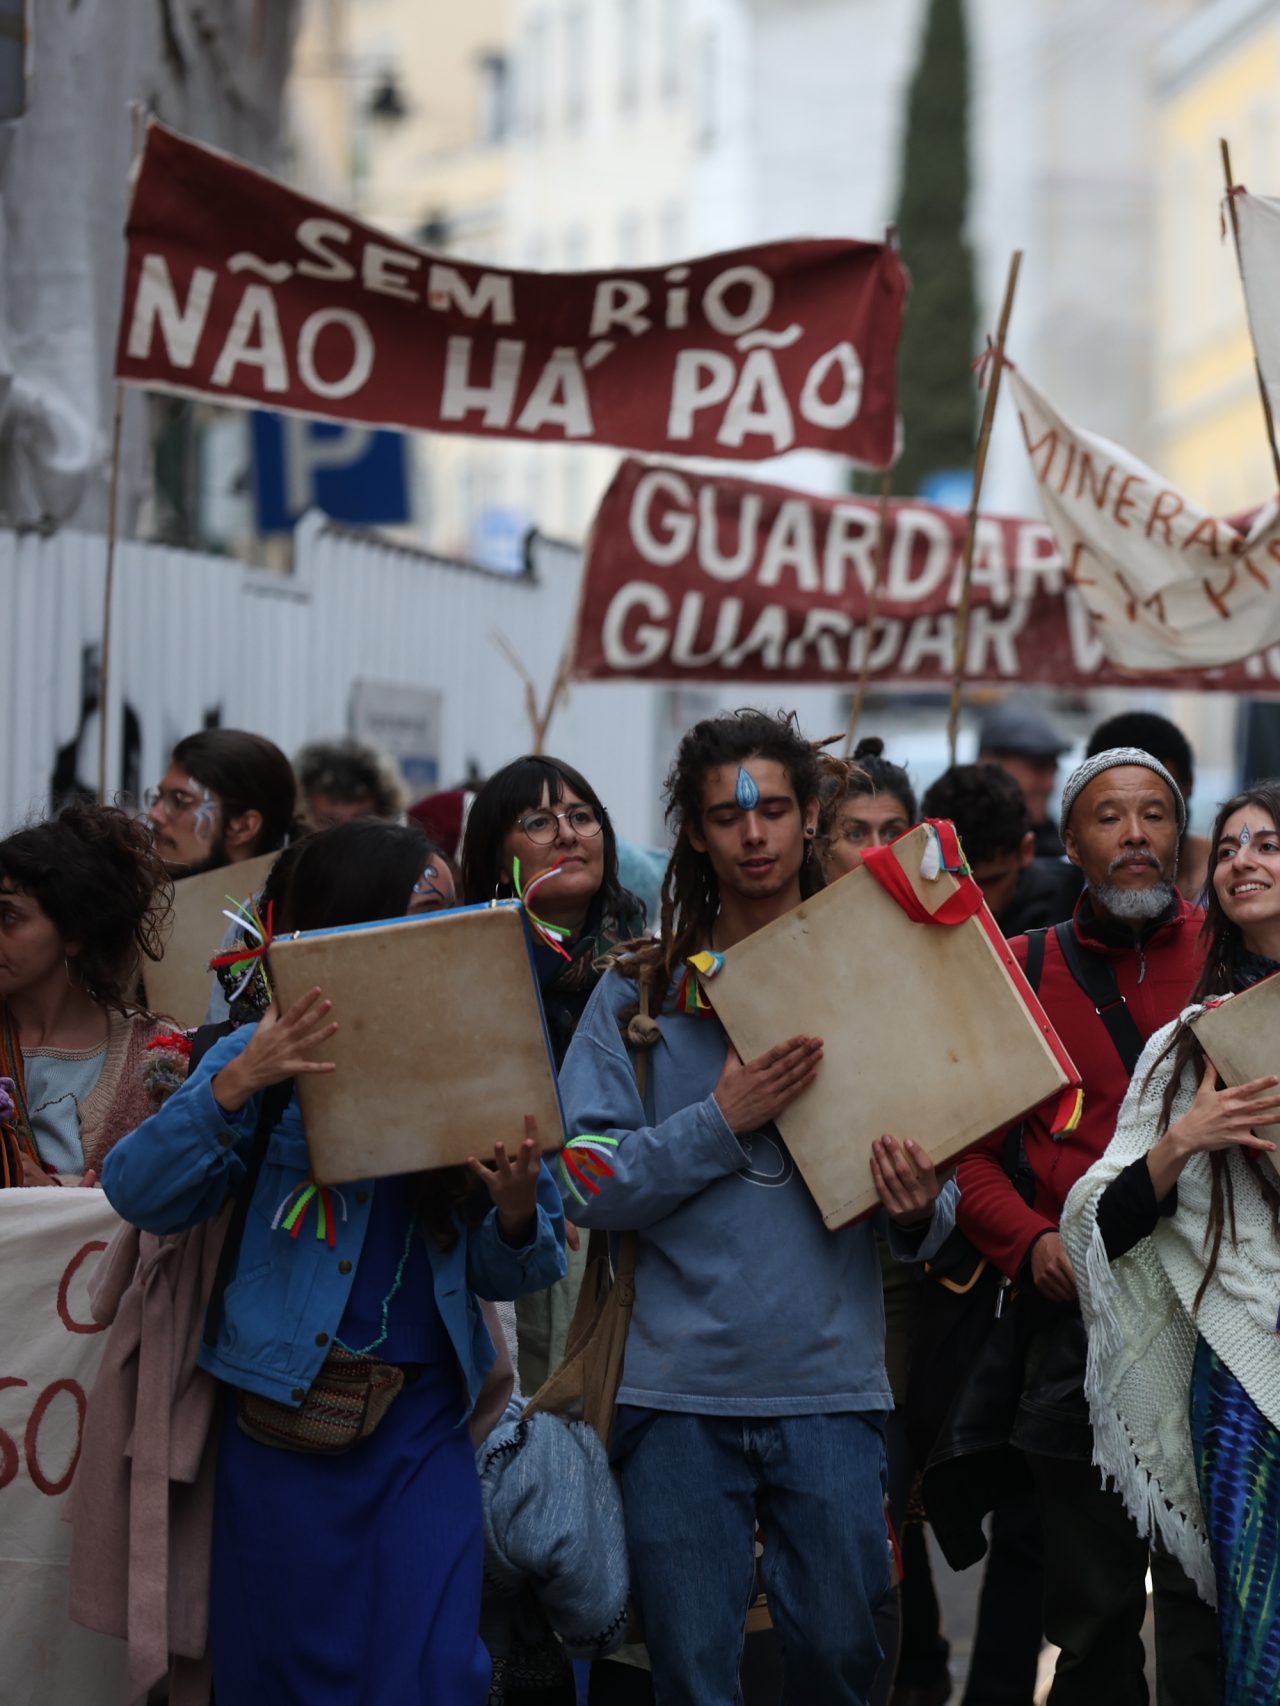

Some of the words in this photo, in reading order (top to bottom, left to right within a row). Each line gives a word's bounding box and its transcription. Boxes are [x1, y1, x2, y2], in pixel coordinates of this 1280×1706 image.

[296, 218, 516, 324] SEM
[127, 251, 374, 399] NÃO
[439, 335, 616, 438] HÁ
[668, 323, 863, 452] PÃO
[282, 412, 376, 519] P
[1018, 410, 1246, 558] MINERA
[629, 471, 1066, 607] GUARDAR
[602, 580, 1030, 676] GUARDAR
